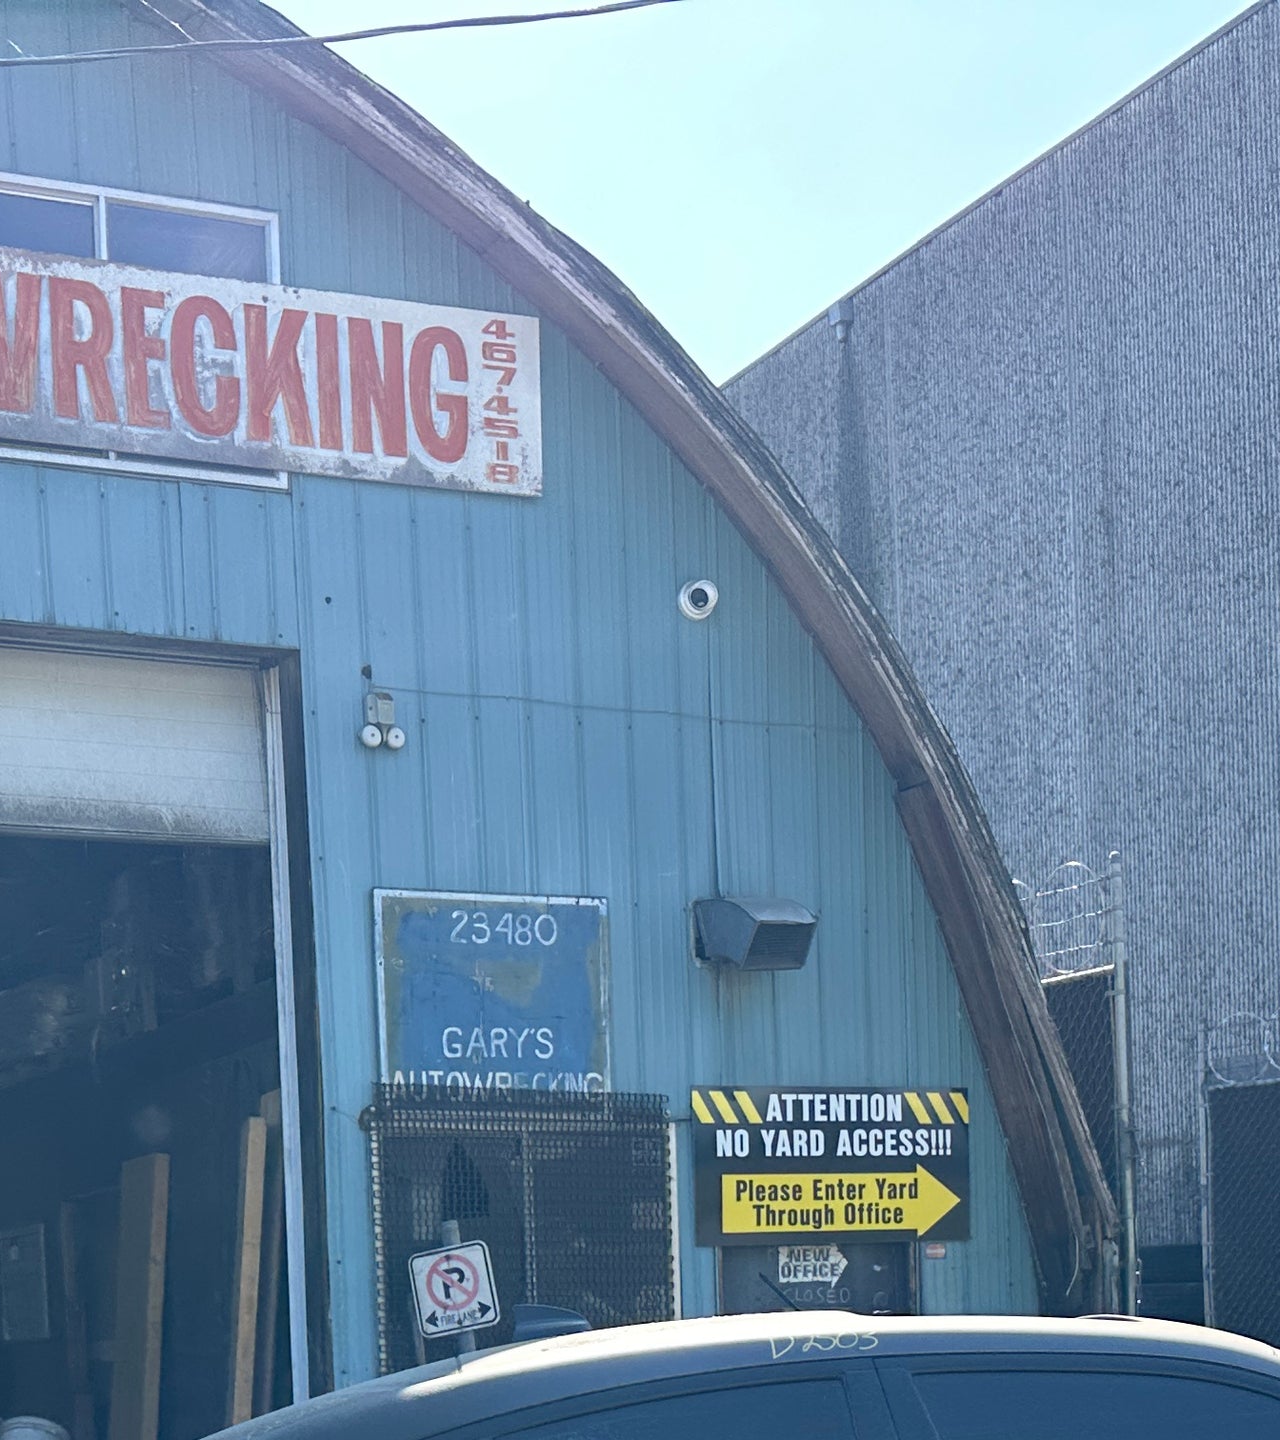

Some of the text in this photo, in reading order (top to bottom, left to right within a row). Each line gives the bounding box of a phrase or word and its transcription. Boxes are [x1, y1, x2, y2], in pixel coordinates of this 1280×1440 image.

[450, 910, 558, 946] 23480
[442, 1026, 554, 1059] GARY'S
[766, 1093, 902, 1122] ATTENTION
[716, 1128, 952, 1157] NO YARD ACCESS!!!
[736, 1178, 919, 1202] Please Enter Yard
[752, 1202, 904, 1229] Through Office
[787, 1248, 831, 1262] NEW
[781, 1261, 841, 1279] OFFICE
[782, 1287, 850, 1304] CLOSED
